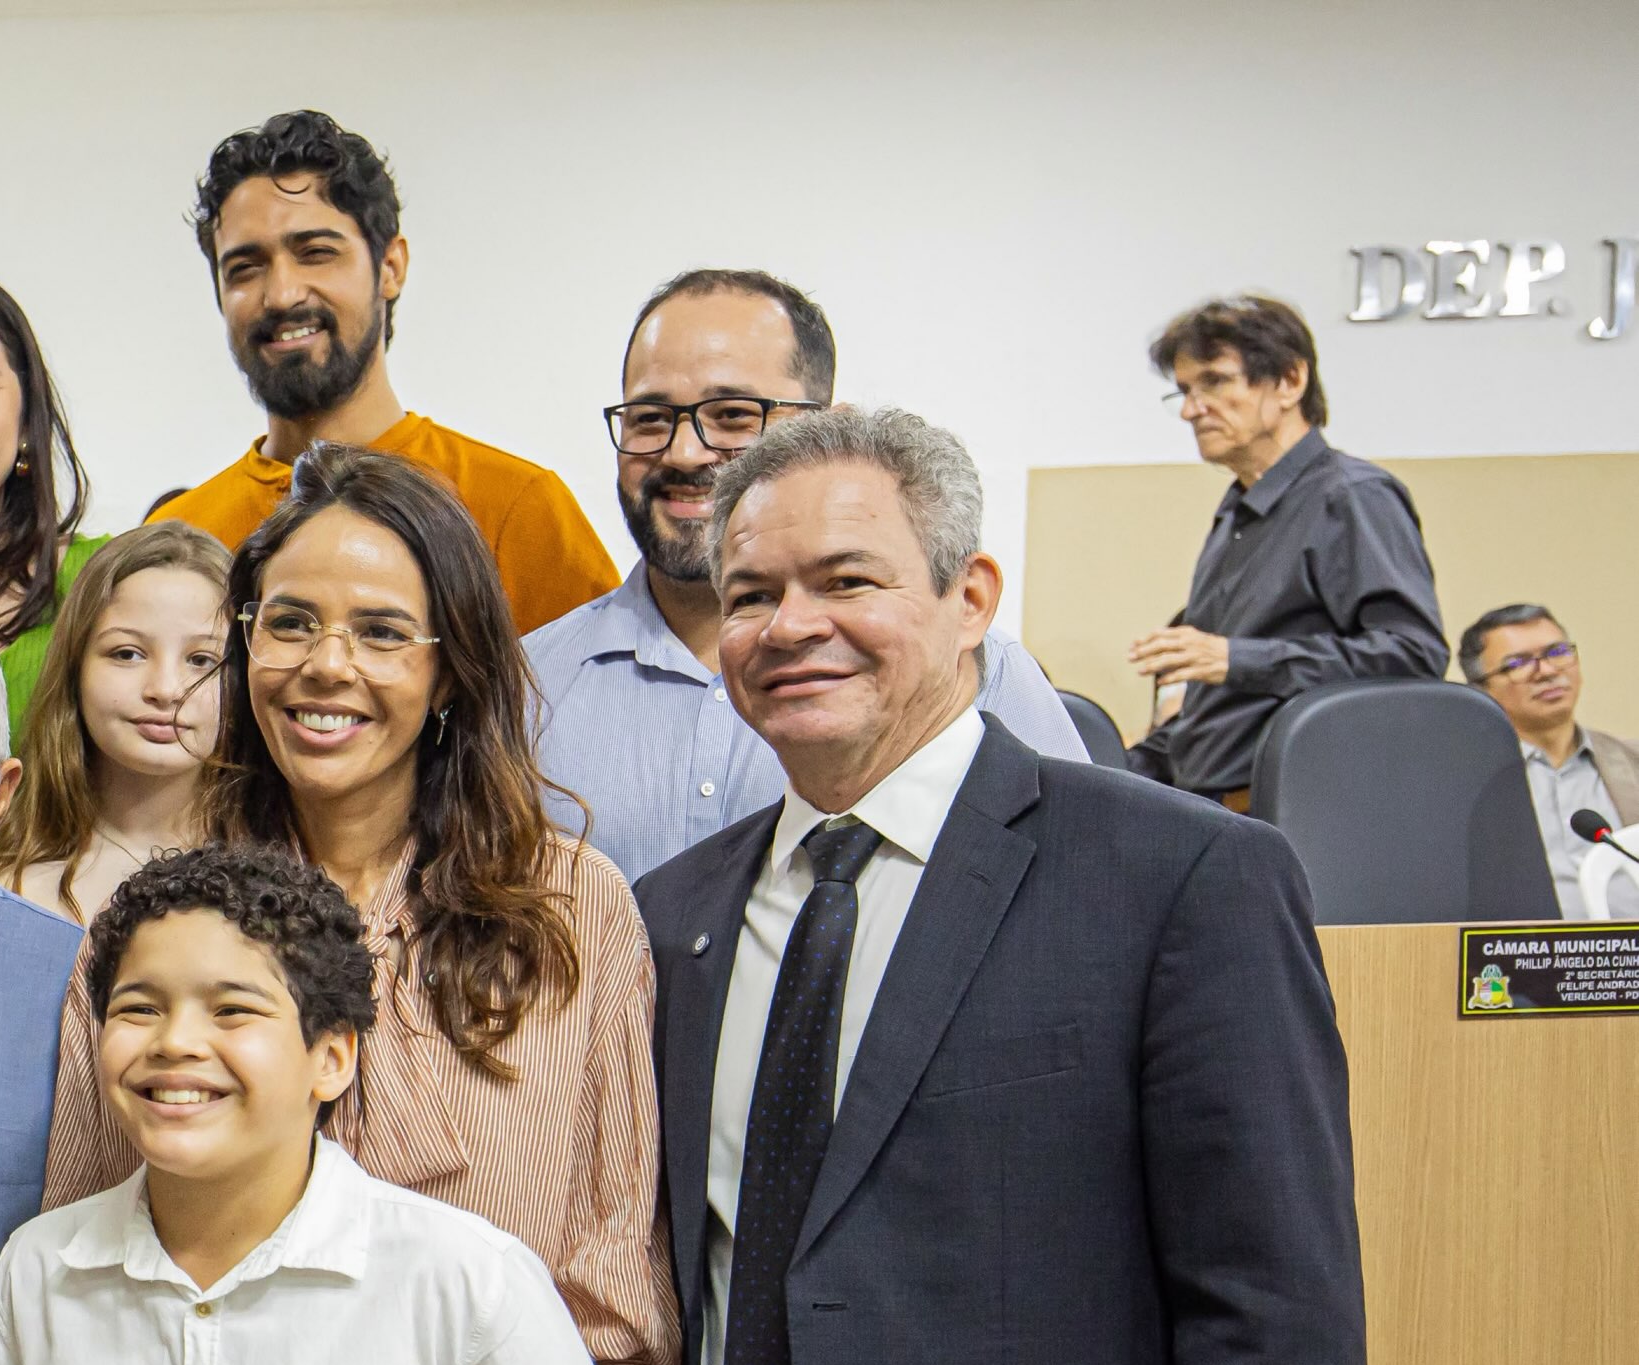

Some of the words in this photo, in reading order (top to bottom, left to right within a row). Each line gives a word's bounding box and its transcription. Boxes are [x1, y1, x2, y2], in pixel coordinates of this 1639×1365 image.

[1348, 238, 1566, 321] DEP.
[1588, 239, 1639, 340] J
[1483, 940, 1550, 955] CÂMARA
[1554, 939, 1639, 953] MUNICIPAL
[1515, 957, 1552, 969] PHILLIP
[1553, 954, 1595, 968] ÂNGELO
[1596, 956, 1610, 967] DA
[1612, 955, 1639, 967] CUNH
[1596, 980, 1639, 990] ANDRAD
[1561, 990, 1617, 1001] VEREADOR
[1625, 990, 1639, 1000] PD
